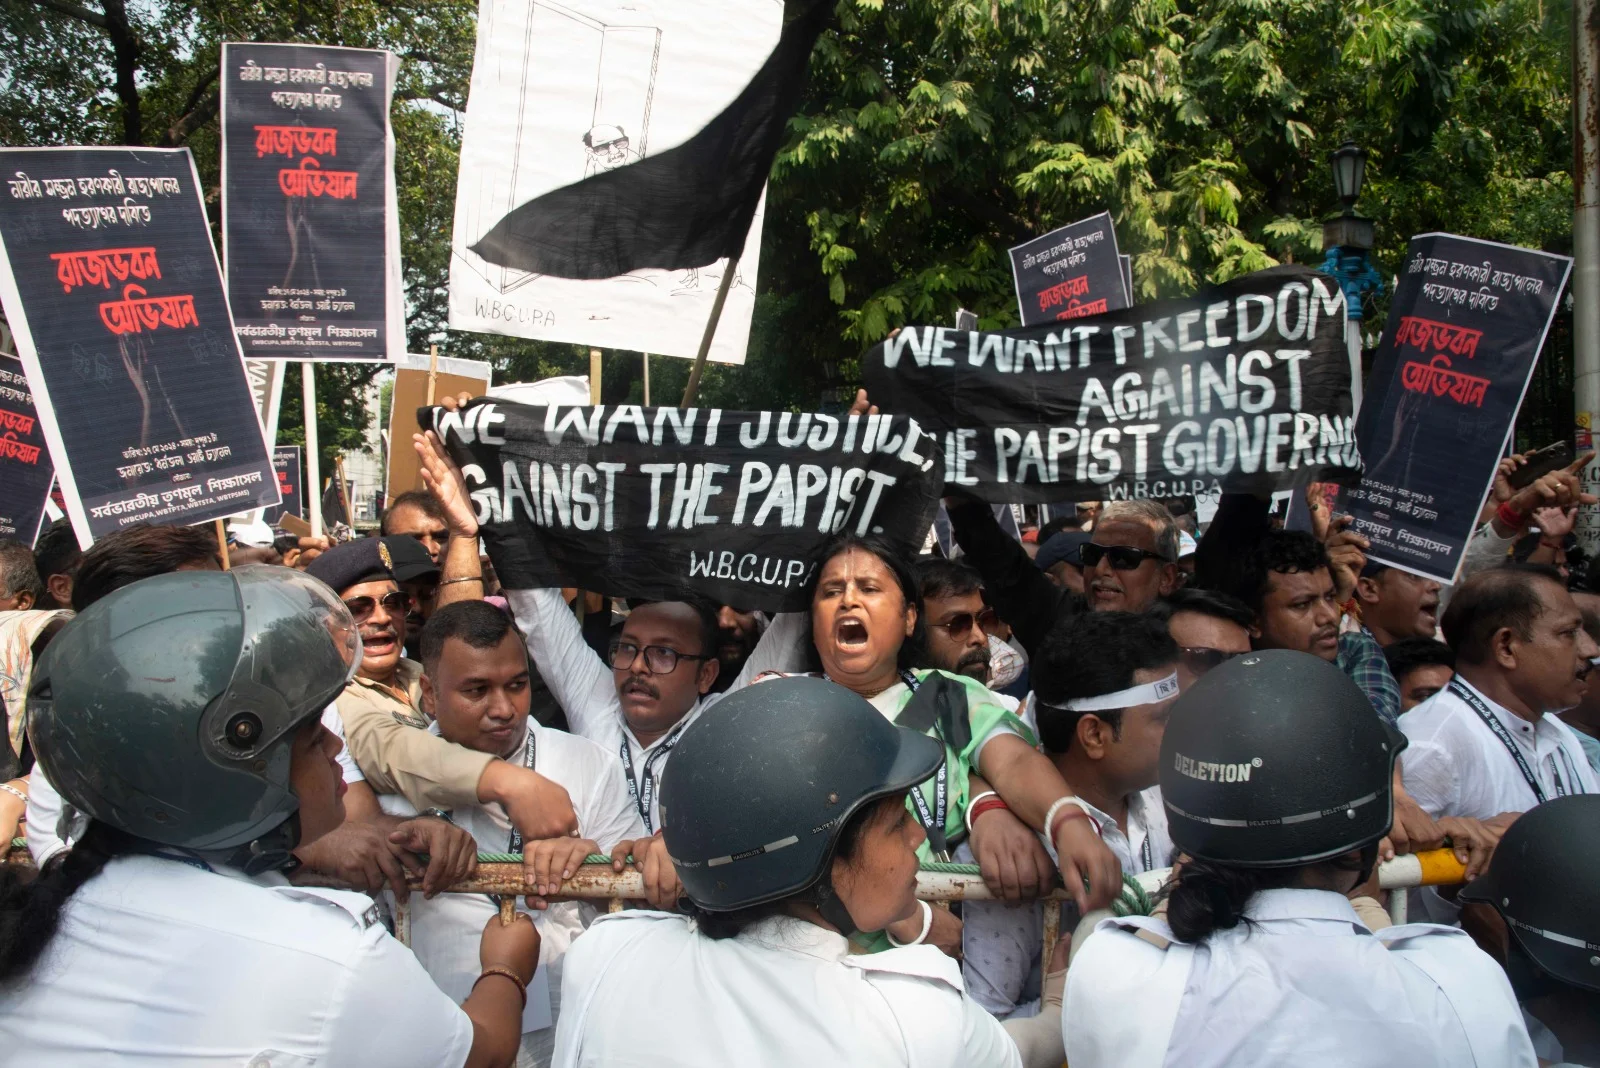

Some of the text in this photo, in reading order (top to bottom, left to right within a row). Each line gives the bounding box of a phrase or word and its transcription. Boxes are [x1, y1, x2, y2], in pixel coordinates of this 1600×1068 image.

[254, 125, 337, 158] রাজভবন
[8, 172, 43, 199] নারীর
[77, 169, 126, 198] হরণকারী
[126, 177, 181, 198] রাজ্যপালের
[278, 157, 358, 199] অভিযান
[62, 197, 151, 229] পদত্যাগের দাবিতে
[50, 247, 162, 294] রাজভবন
[1449, 261, 1491, 283] হরণকারী
[1492, 270, 1543, 295] রাজ্যপালের
[99, 283, 199, 334] অভিযান
[1037, 275, 1089, 312] রাজভবন
[1423, 283, 1499, 313] পদত্যাগের দাবিতে
[288, 328, 322, 340] তৃণমূল
[327, 325, 377, 338] শিক্ষাসেল
[883, 277, 1348, 374] WE WANT FREEDOM
[1394, 316, 1483, 360] রাজভবন
[1076, 349, 1313, 427] AGAINST
[1402, 354, 1491, 408] অভিযান
[432, 403, 506, 446] WE
[544, 403, 724, 447] WANT
[995, 423, 1162, 485] PAPIST
[90, 494, 159, 518] সর্বভারতীয়
[162, 484, 202, 507] তৃণমূল
[207, 471, 262, 493] শিক্ষাসেল
[461, 460, 897, 537] GAINST THE PAPIST.
[1356, 518, 1393, 539] তৃণমূল
[1396, 528, 1452, 556] শিক্ষাসেল
